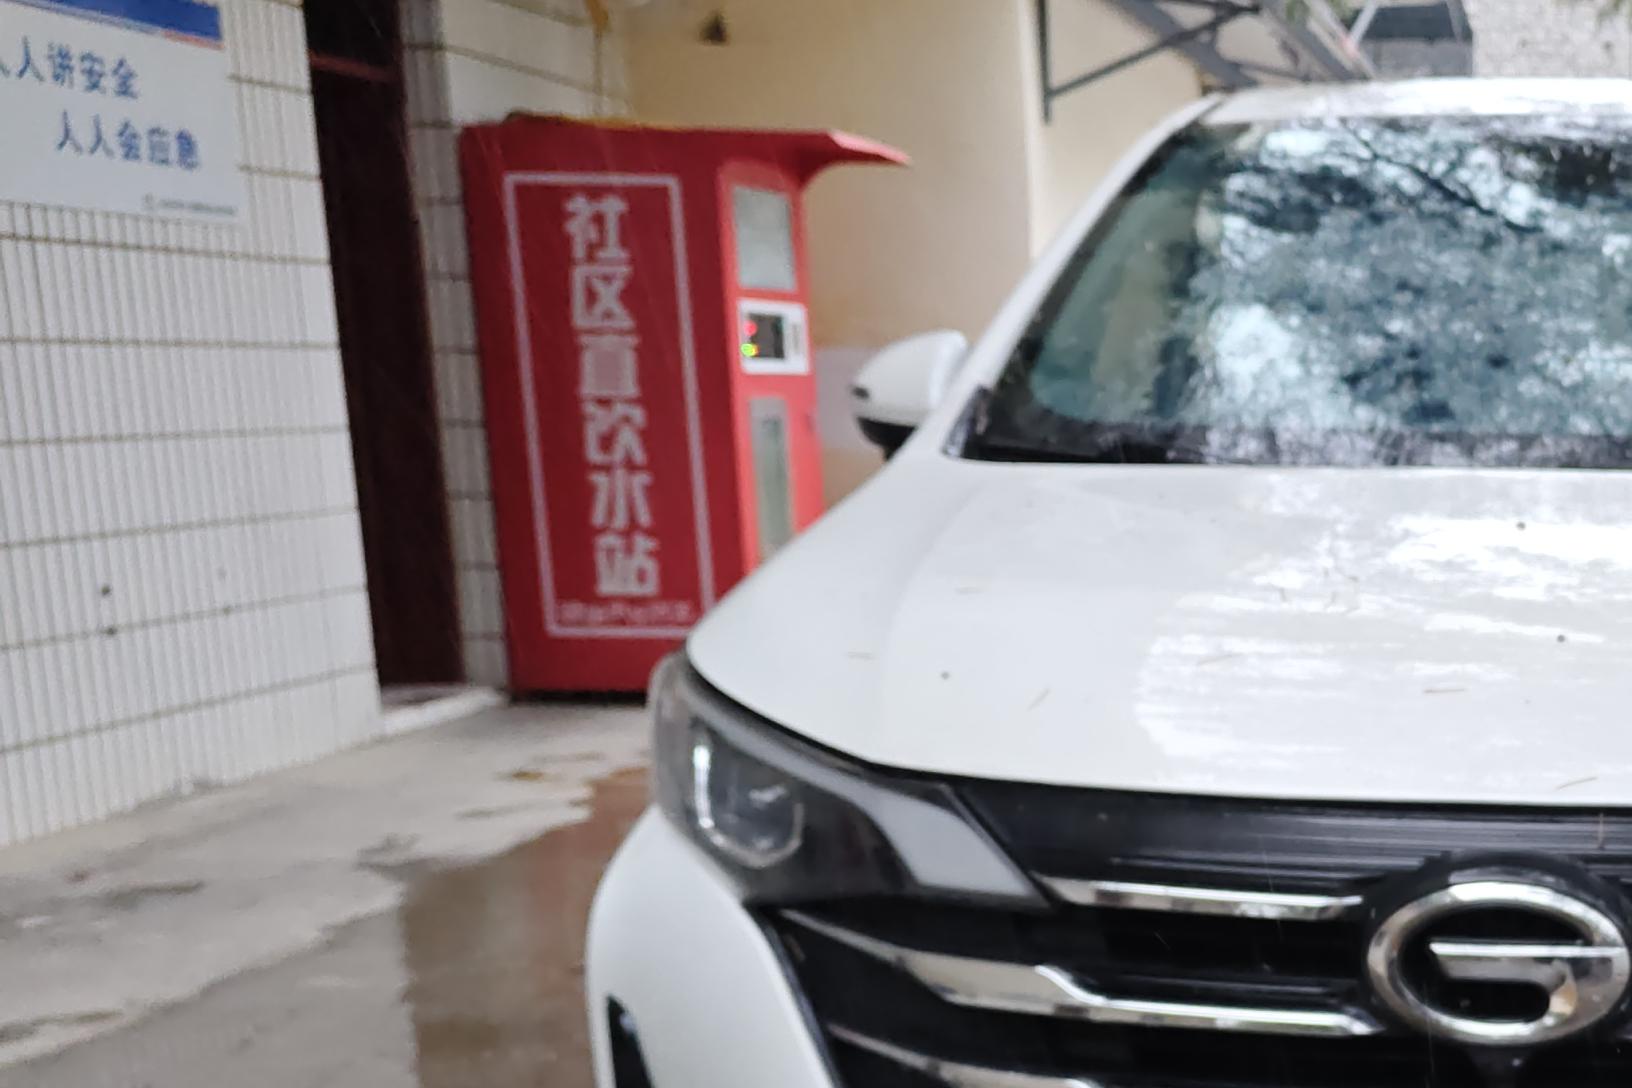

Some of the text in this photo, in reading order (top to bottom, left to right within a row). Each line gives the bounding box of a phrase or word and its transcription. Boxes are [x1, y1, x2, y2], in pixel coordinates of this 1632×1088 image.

[56, 109, 199, 171] 人人会应急
[564, 193, 660, 597] 社区直饮水站
